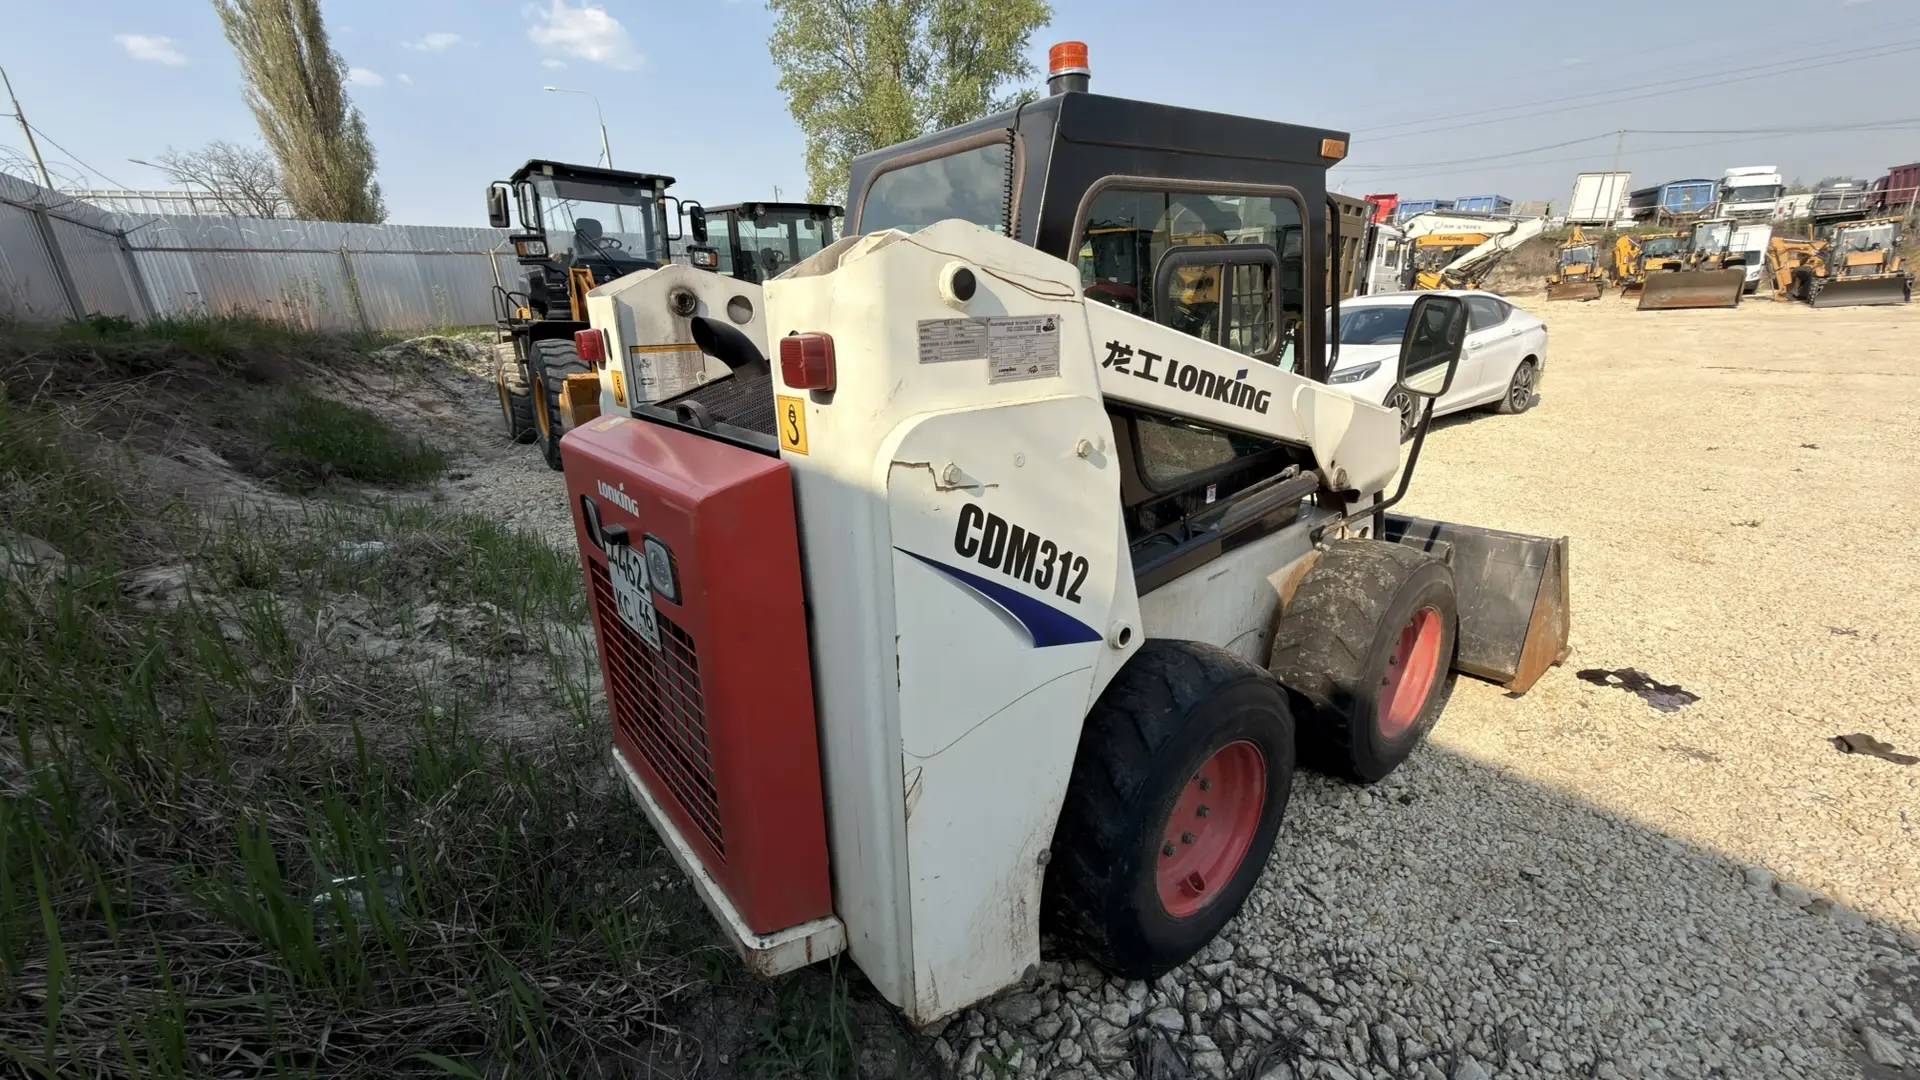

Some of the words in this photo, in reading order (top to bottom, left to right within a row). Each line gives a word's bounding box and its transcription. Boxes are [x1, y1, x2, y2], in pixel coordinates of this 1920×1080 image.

[1102, 340, 1162, 383] 龙工
[954, 502, 1089, 605] CDM312
[639, 600, 653, 632] 46
